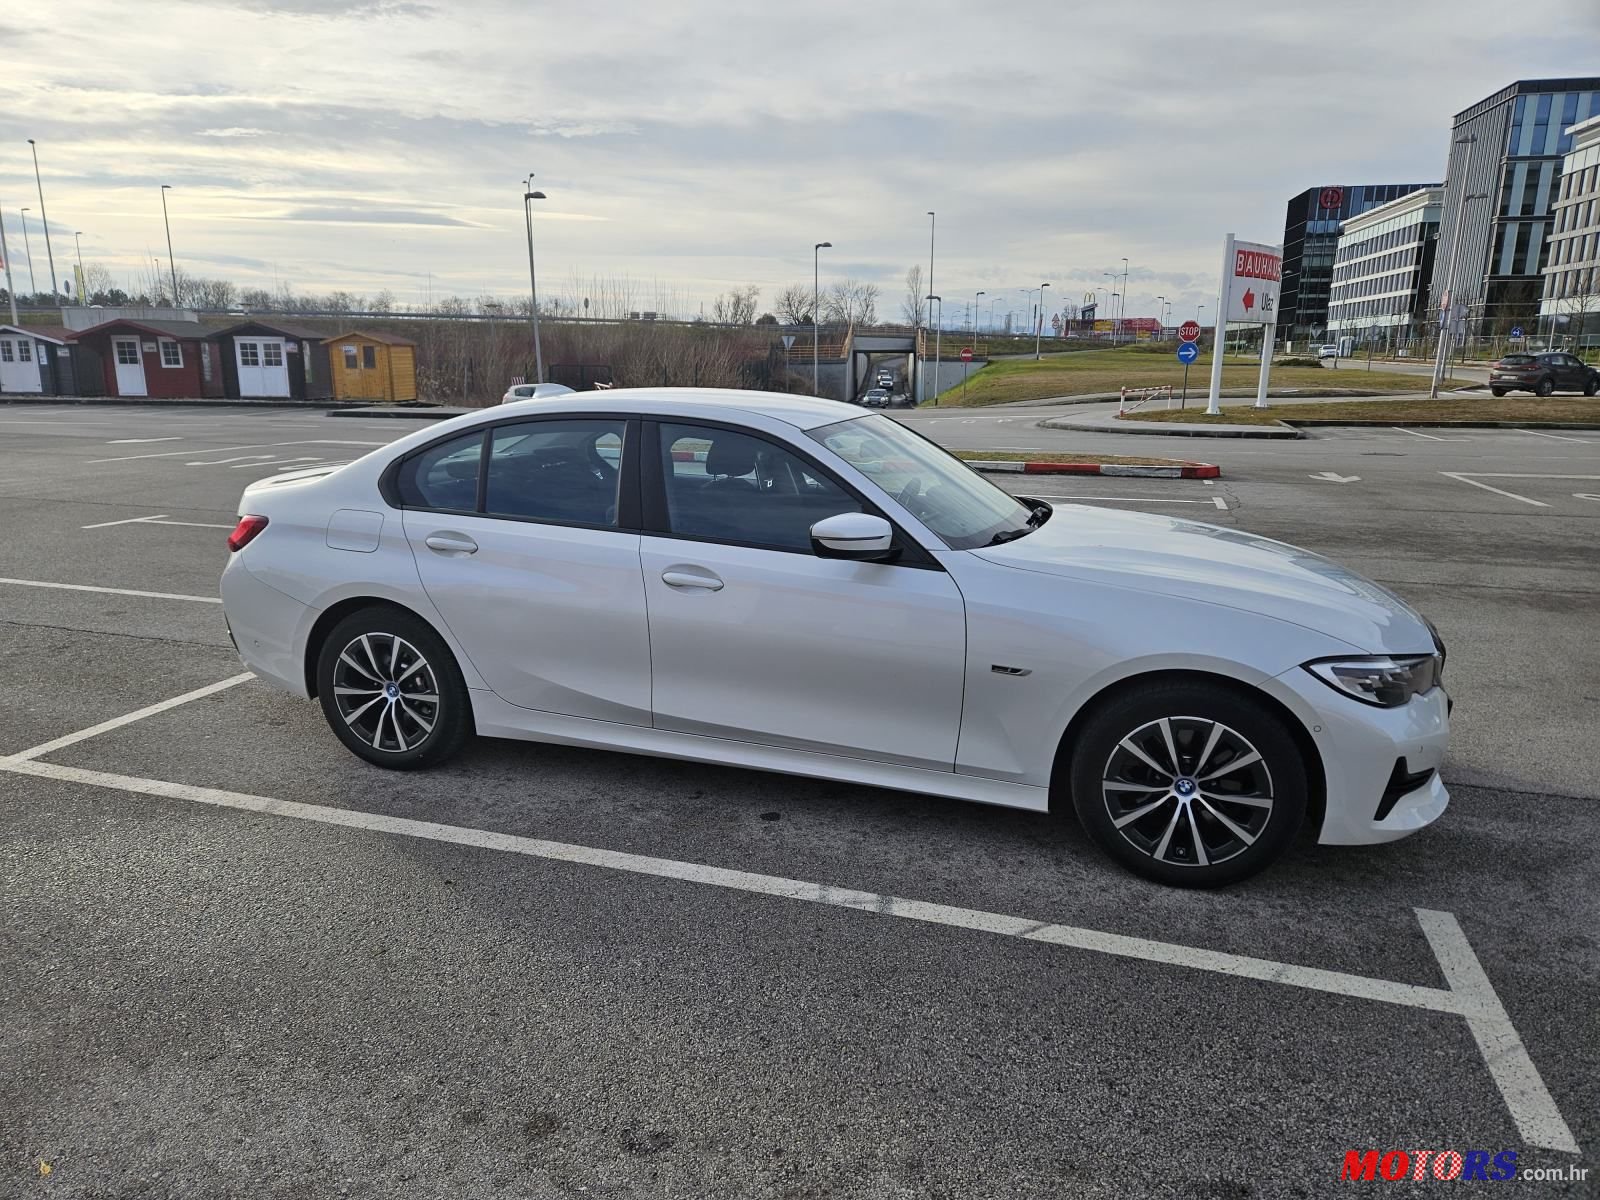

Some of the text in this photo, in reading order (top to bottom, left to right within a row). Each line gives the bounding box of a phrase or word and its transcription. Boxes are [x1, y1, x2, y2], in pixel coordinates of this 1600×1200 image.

[1236, 253, 1282, 278] BAUHAUS
[1261, 292, 1274, 311] Ulaz
[1180, 326, 1199, 336] STOP
